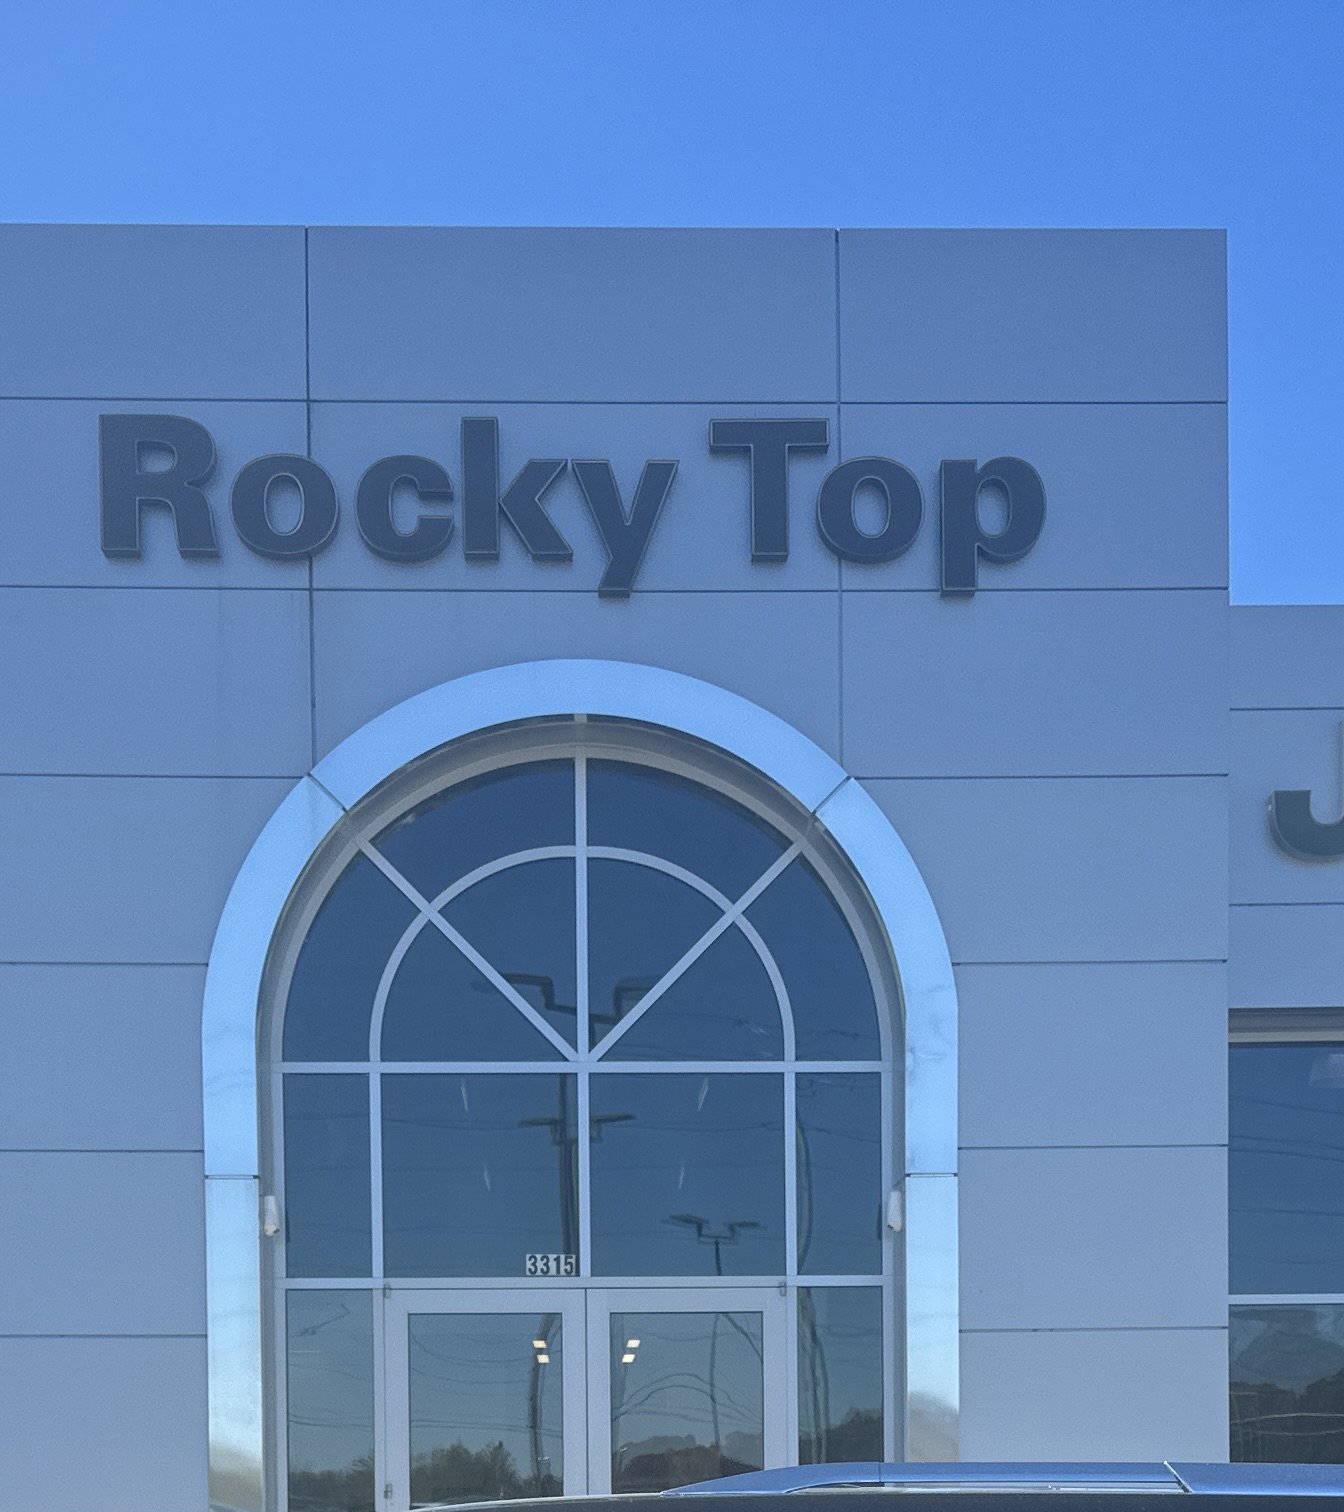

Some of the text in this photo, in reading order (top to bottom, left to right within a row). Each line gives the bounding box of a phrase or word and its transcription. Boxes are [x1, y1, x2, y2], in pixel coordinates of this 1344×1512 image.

[98, 414, 1046, 598] Rocky Top
[528, 1254, 574, 1275] 3315
